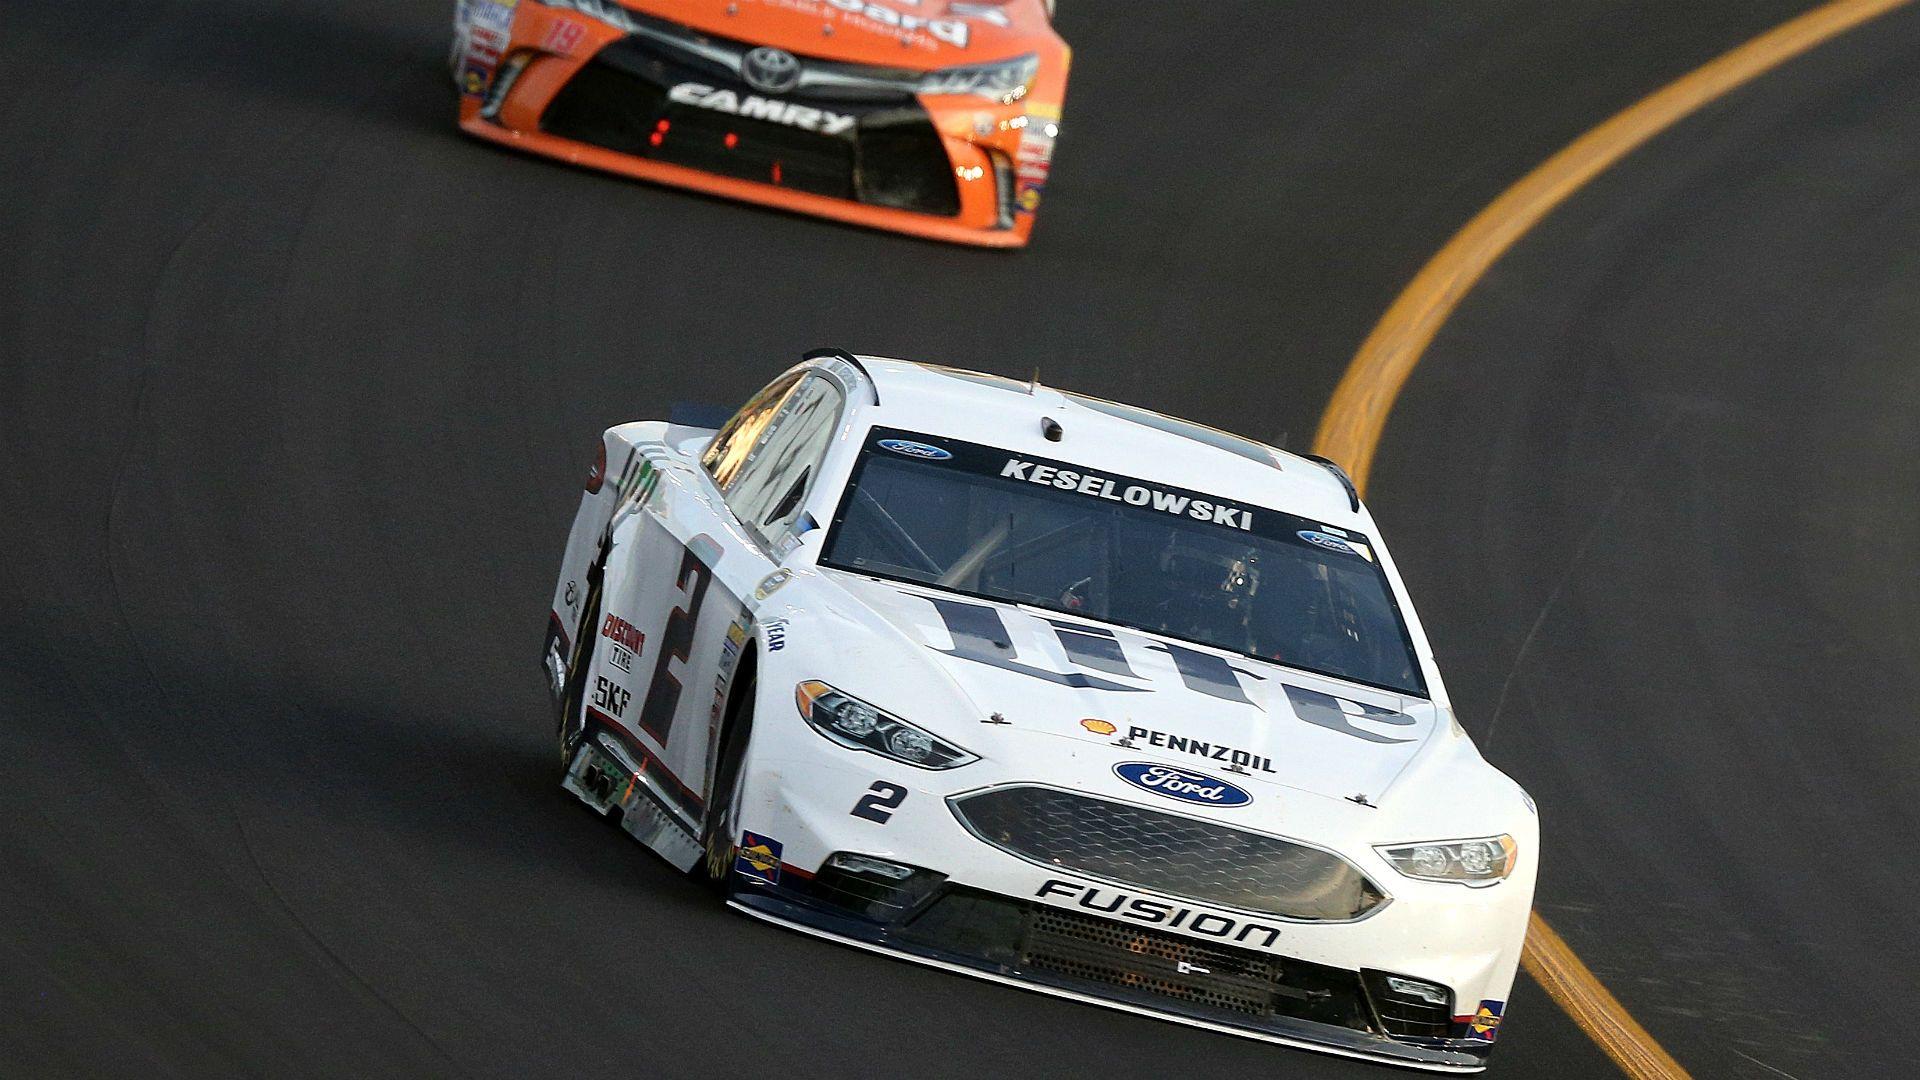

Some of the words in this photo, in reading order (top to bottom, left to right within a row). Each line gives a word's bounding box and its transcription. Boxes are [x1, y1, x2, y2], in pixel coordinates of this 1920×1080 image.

[668, 82, 856, 135] CAMRY
[1000, 458, 1253, 532] KESELOWSKI
[638, 532, 725, 750] 2
[594, 675, 631, 718] SKF
[1127, 725, 1278, 774] PENNZOIL
[850, 780, 908, 824] 2
[1140, 766, 1224, 801] Ford
[1034, 879, 1281, 948] FUSION
